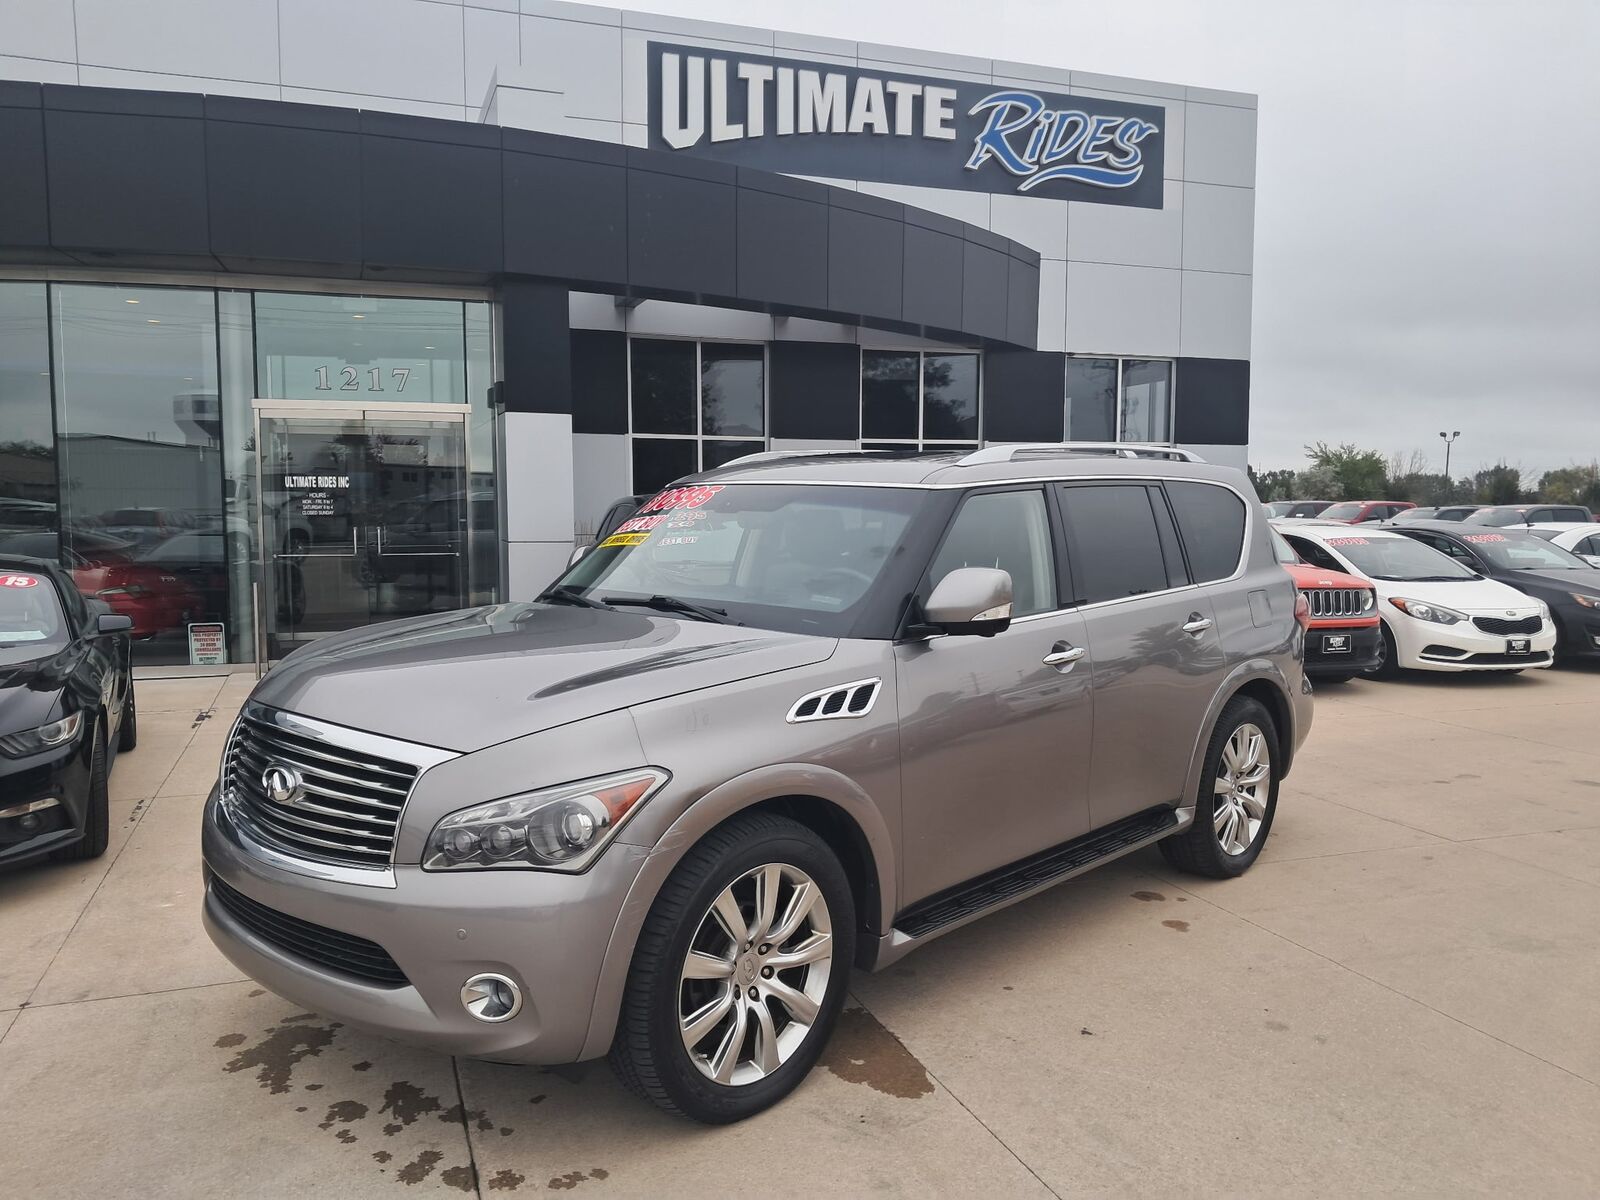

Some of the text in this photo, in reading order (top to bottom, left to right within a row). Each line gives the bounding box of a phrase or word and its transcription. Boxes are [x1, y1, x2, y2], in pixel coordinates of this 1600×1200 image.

[661, 52, 957, 150] ULTIMATE
[314, 365, 411, 393] 1217
[284, 476, 350, 488] ULTIMATE RIDES INC
